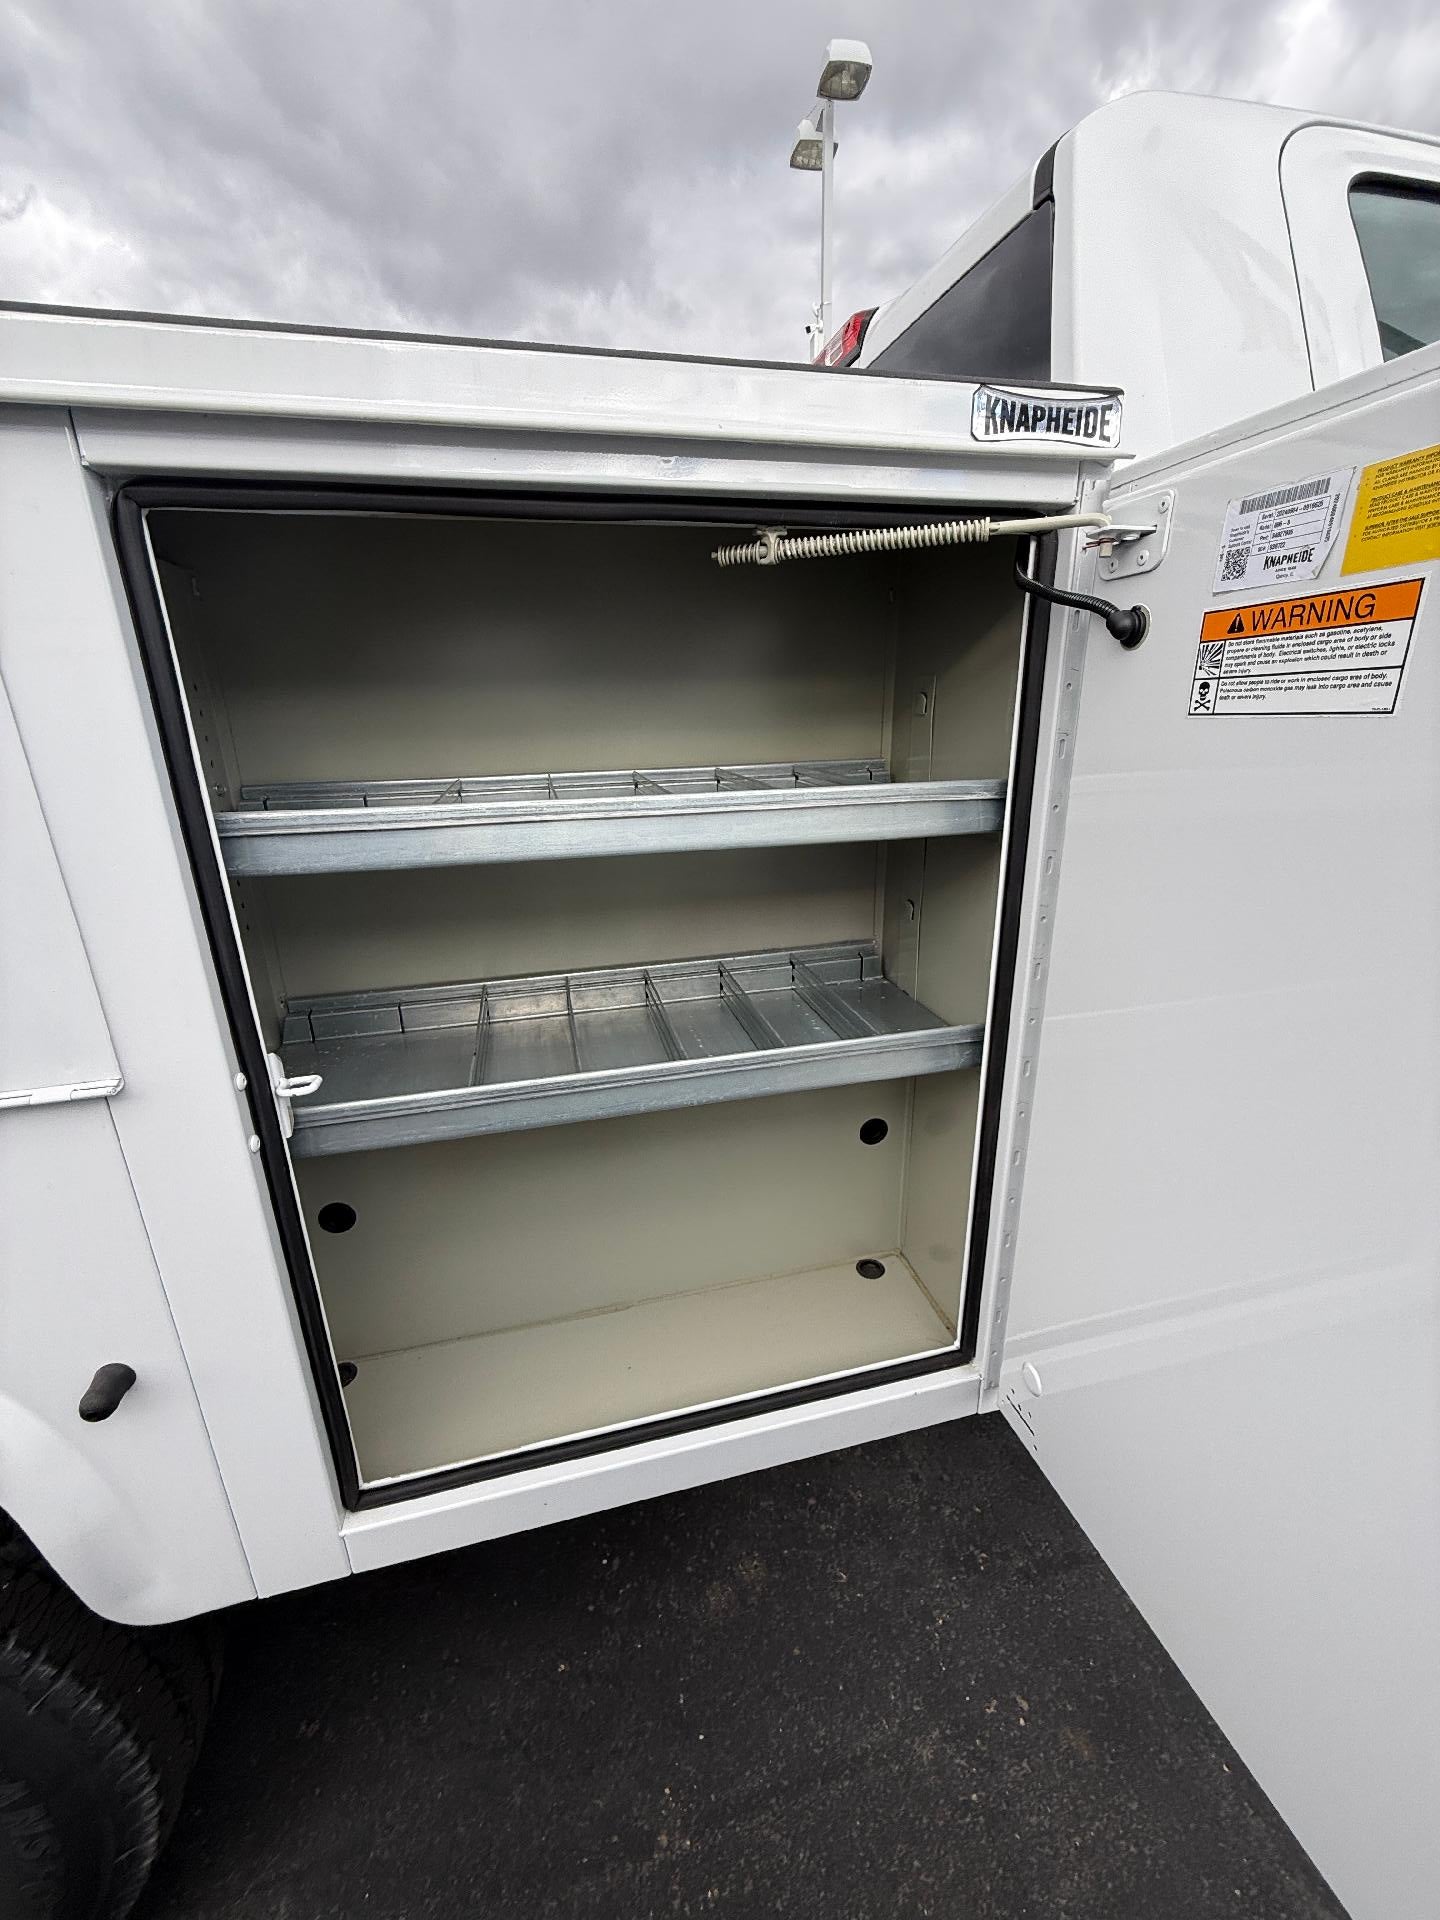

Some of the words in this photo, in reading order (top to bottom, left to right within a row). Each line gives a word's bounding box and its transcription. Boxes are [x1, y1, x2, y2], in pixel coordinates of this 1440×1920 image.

[984, 394, 1113, 442] KNAPHEIDE
[1263, 547, 1314, 569] KNAPHEIDE
[1252, 593, 1376, 632] WARNING
[1352, 625, 1383, 634] acetylene,
[1353, 635, 1369, 643] body
[1278, 656, 1302, 664] explosion
[1370, 672, 1387, 680] body.
